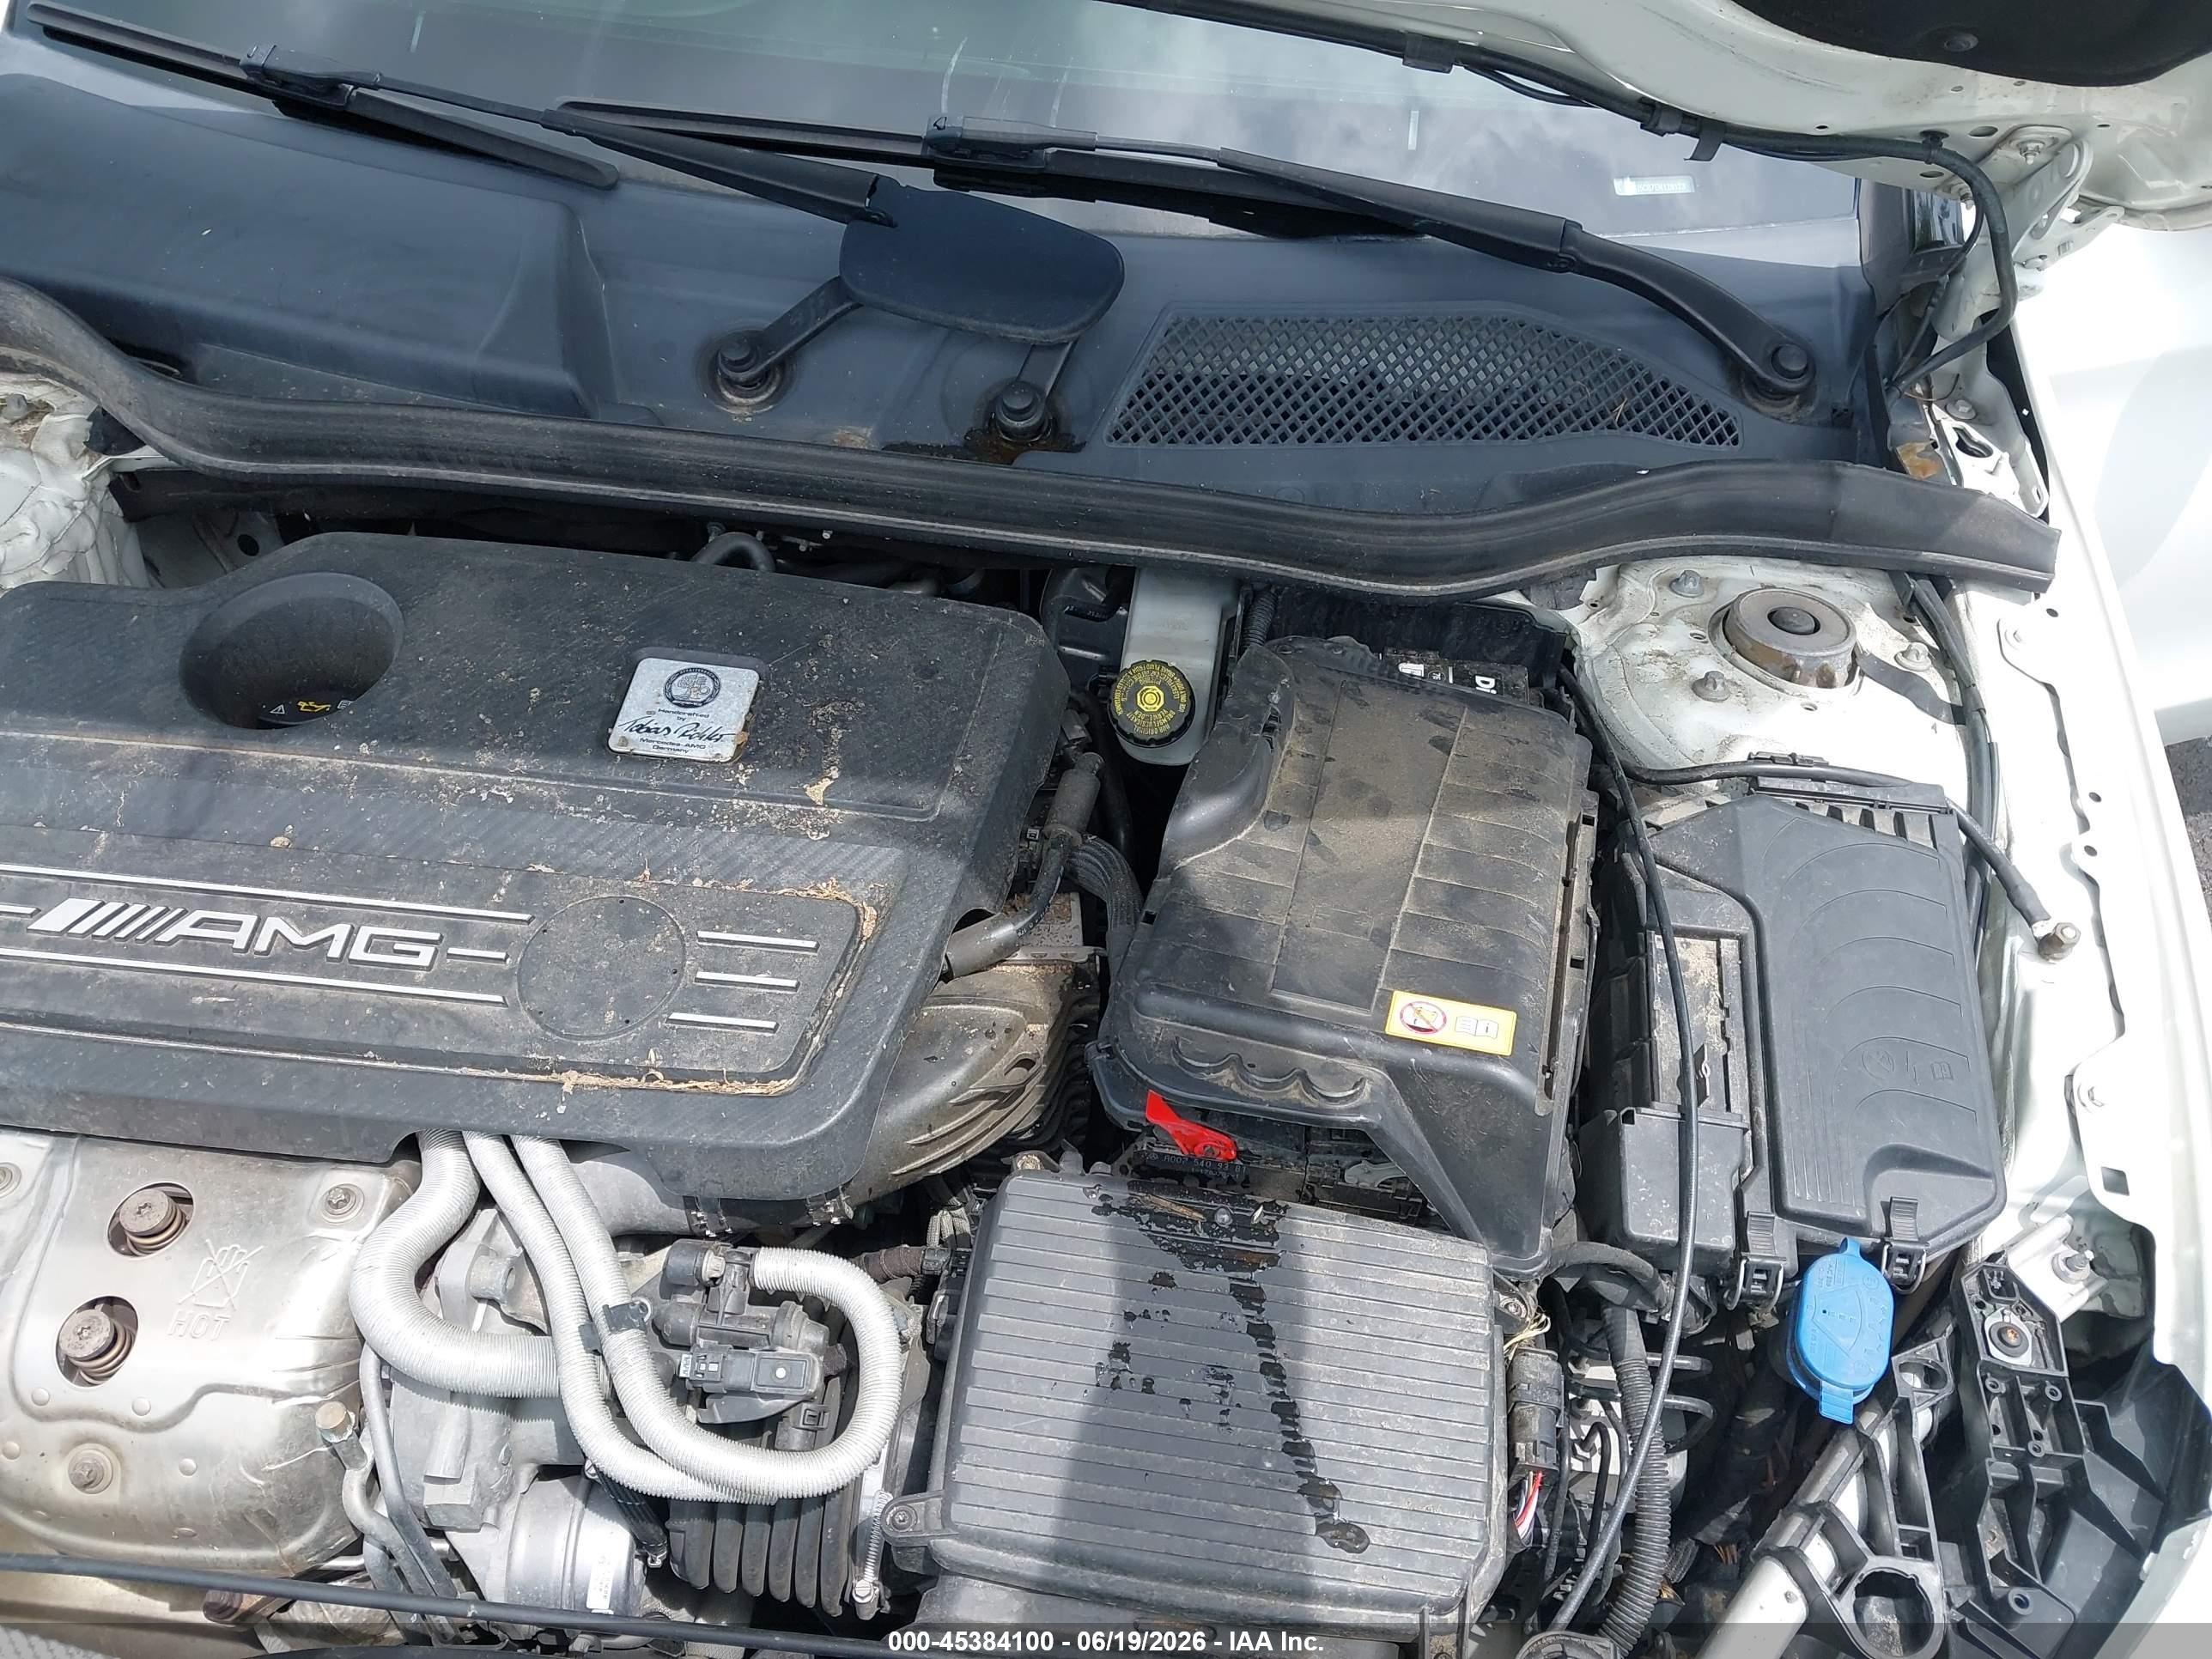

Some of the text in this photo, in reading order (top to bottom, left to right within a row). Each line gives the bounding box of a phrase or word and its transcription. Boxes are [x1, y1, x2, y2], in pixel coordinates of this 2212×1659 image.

[658, 708, 709, 719] Handcrafted
[640, 738, 706, 750] Mercedes-AMG
[652, 744, 690, 754] Germany
[155, 910, 444, 971] AMG
[167, 1309, 231, 1340] HOT
